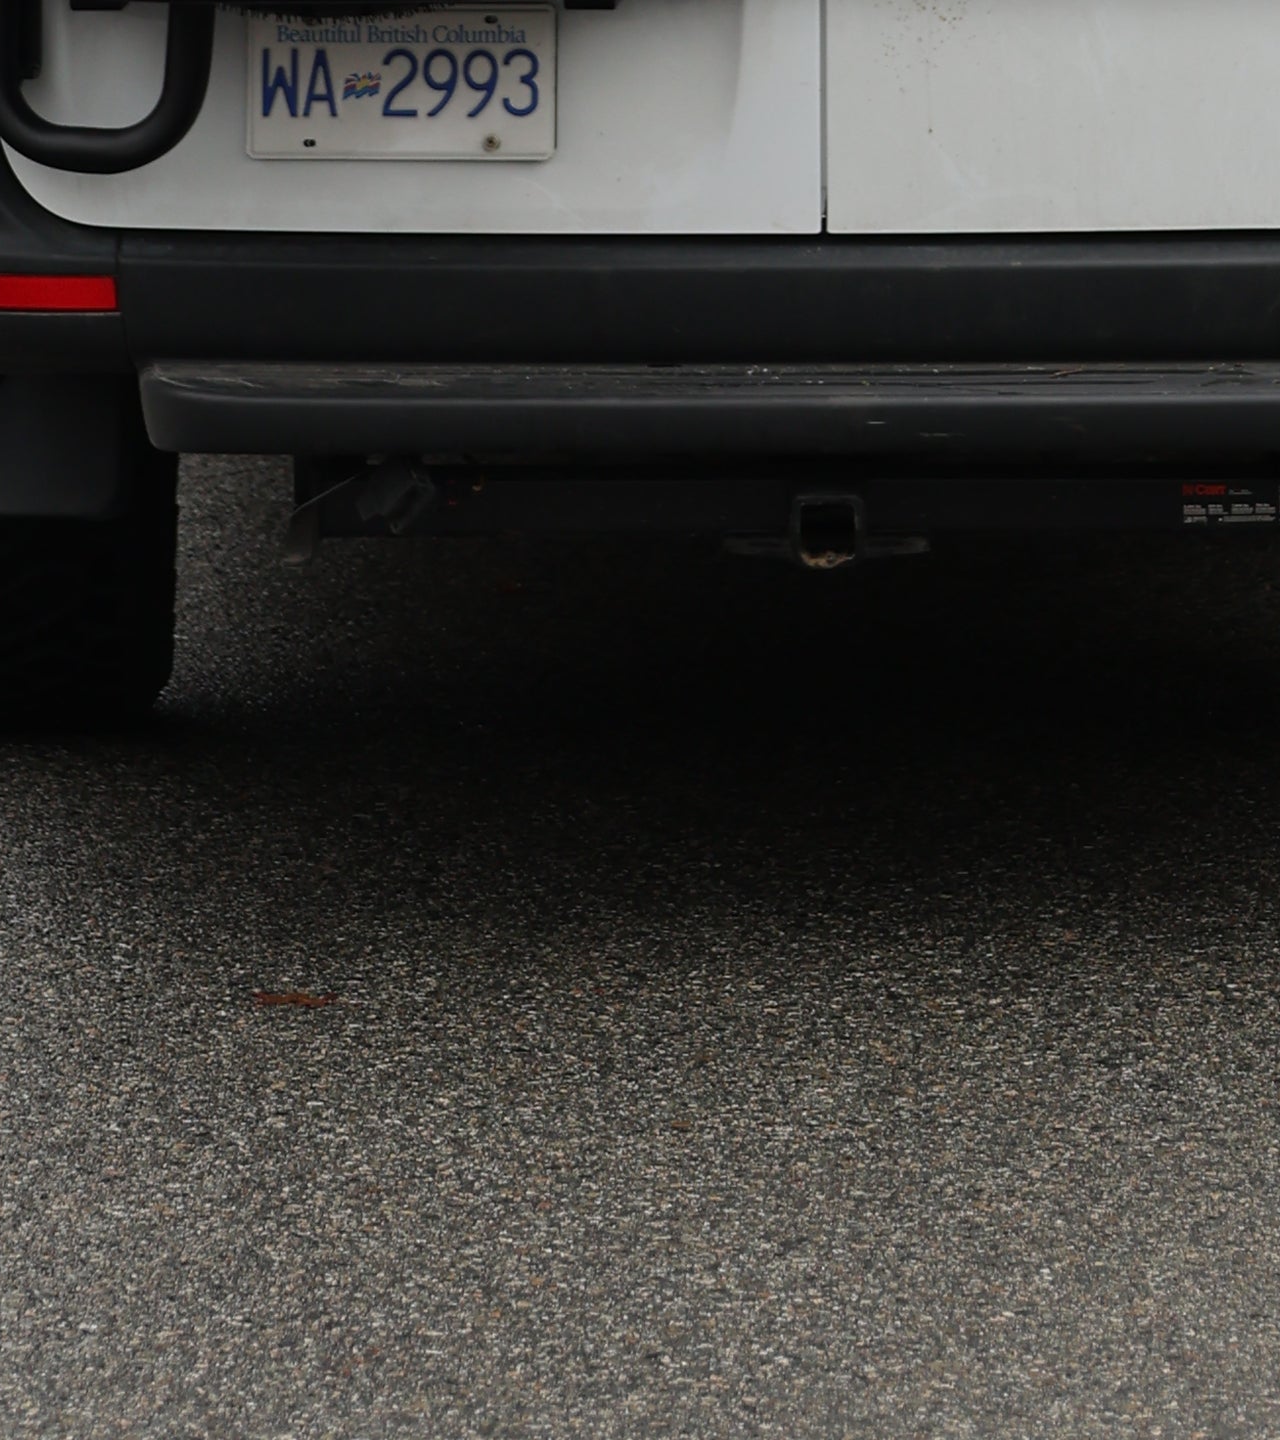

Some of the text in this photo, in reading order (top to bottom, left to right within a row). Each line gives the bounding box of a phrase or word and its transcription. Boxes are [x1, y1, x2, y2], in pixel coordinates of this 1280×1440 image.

[276, 24, 527, 44] Beautiful British Columbia
[261, 48, 540, 118] WA 2993
